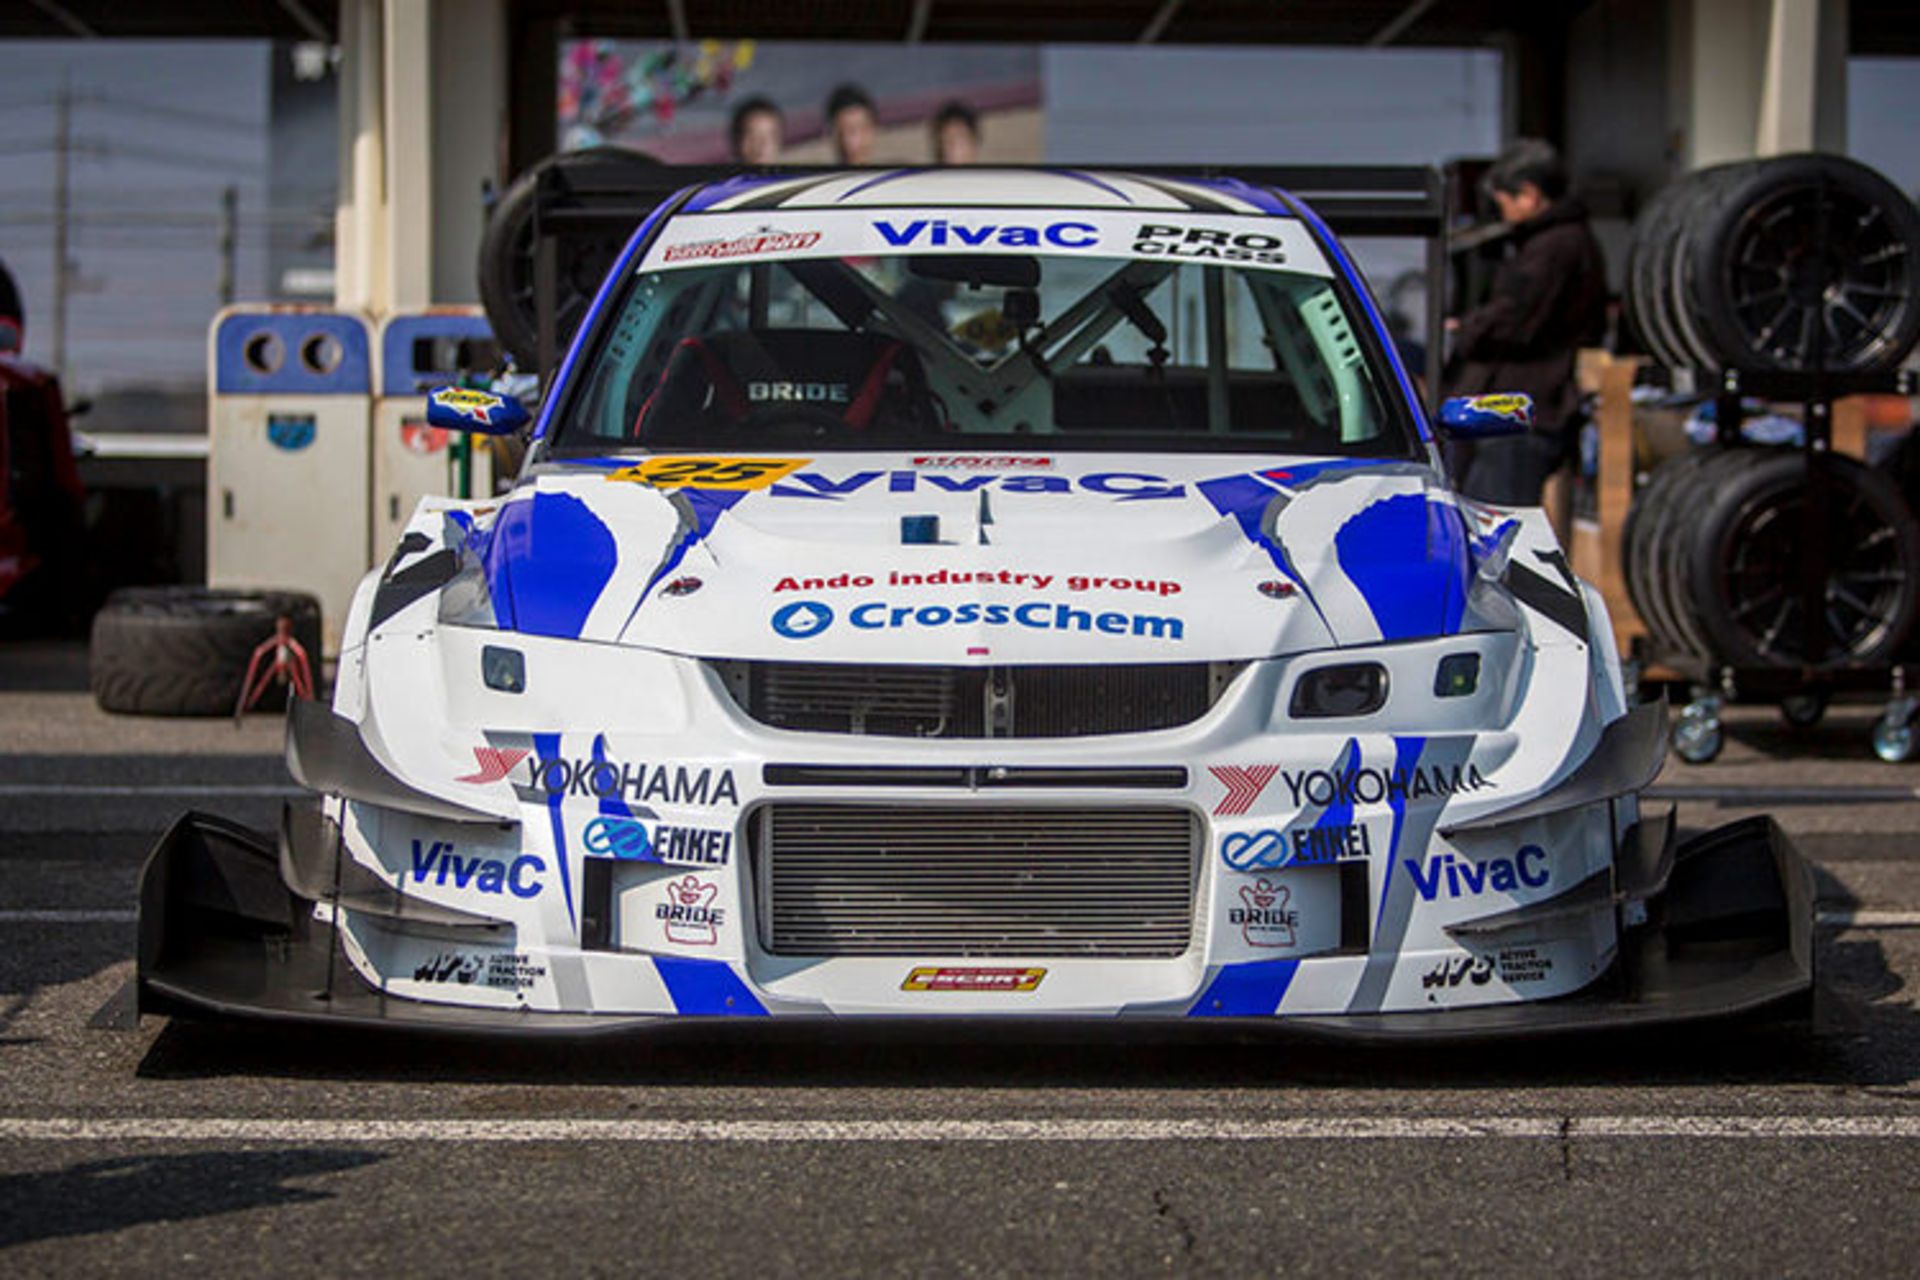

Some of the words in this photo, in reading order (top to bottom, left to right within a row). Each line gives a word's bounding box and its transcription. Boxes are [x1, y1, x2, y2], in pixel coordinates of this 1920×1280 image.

[872, 220, 1099, 248] VivaC
[1136, 224, 1282, 250] PRO
[1131, 241, 1287, 264] CLASS
[748, 382, 849, 402] BRIDE
[645, 461, 789, 484] 25
[770, 470, 1187, 501] VivaC
[772, 573, 874, 592] Ando
[889, 569, 1054, 589] industry
[1067, 573, 1182, 596] group
[849, 602, 1184, 640] CrossChem
[527, 756, 739, 806] YOKOHAMA
[1281, 763, 1497, 807] YOKOHAMA
[652, 824, 732, 865] ENKEI
[1292, 824, 1372, 863] ENKEI
[411, 839, 547, 899] VivaC
[1404, 845, 1550, 902] VivaC
[656, 903, 726, 926] BRIDE
[1228, 908, 1299, 928] BRIDE
